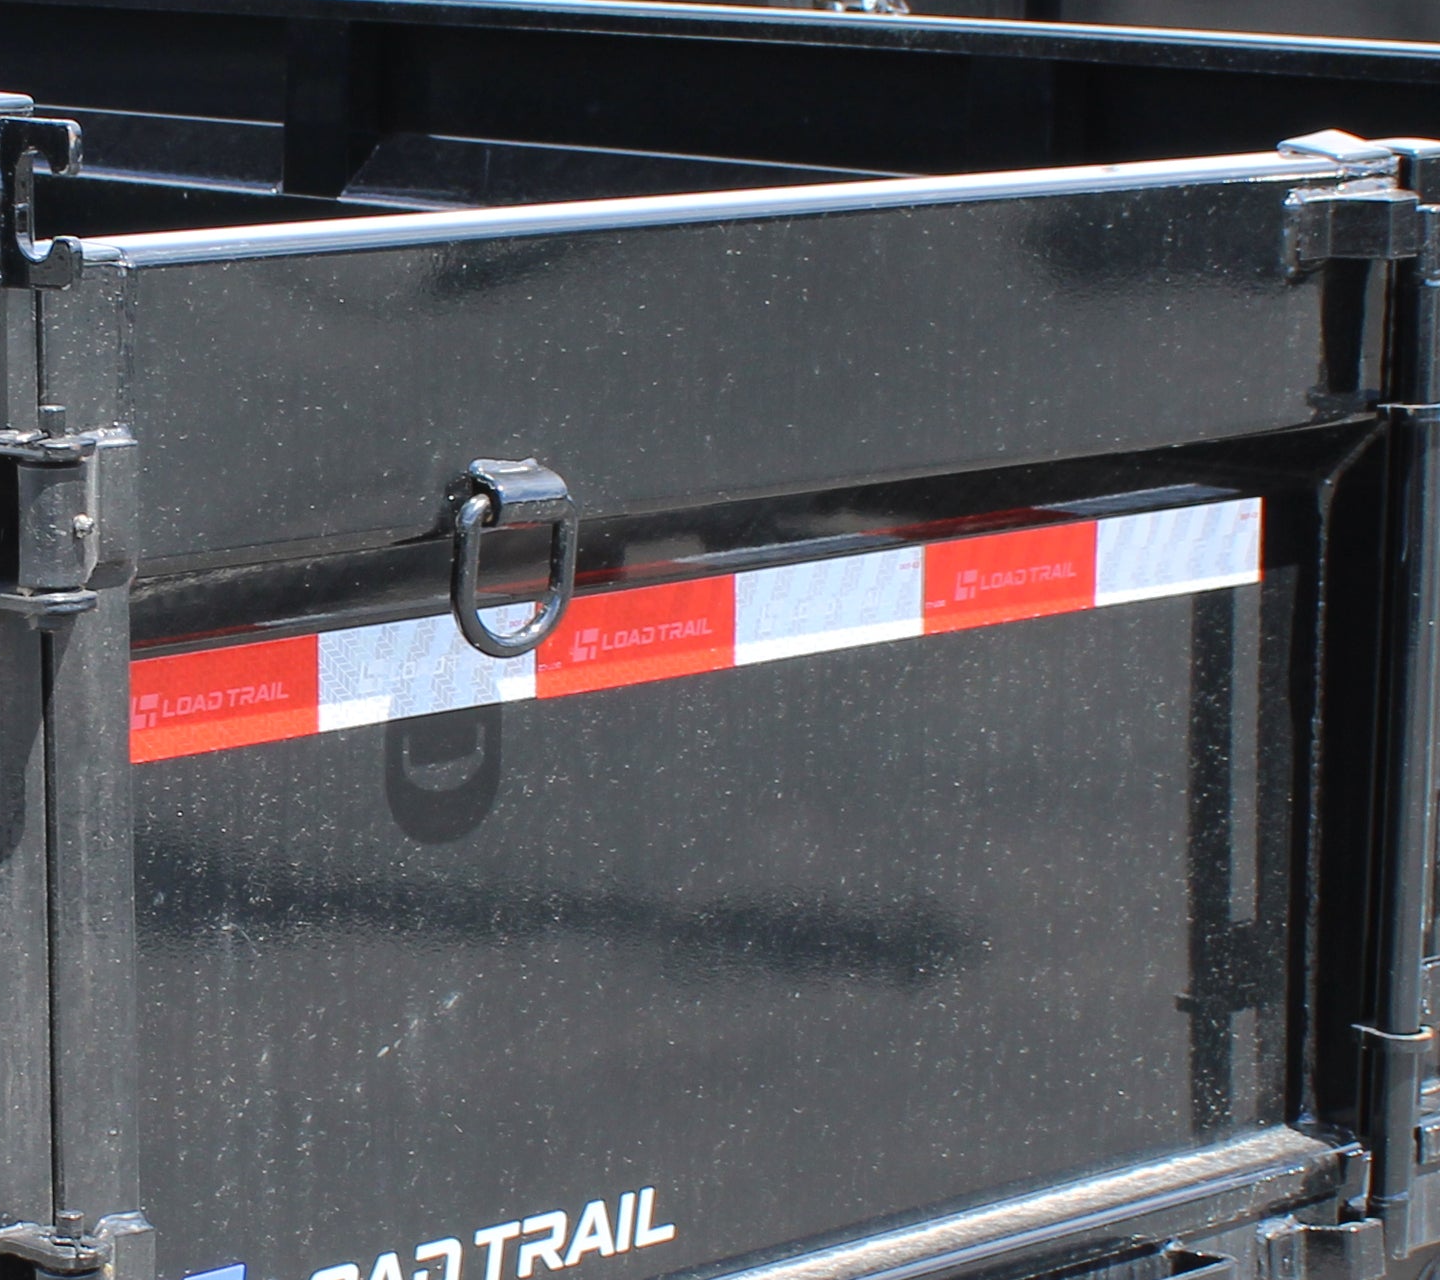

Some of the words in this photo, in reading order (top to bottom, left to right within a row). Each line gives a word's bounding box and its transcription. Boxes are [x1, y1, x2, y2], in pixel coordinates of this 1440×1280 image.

[979, 569, 1026, 592] LOAD
[1030, 560, 1077, 584] TRAIL
[602, 628, 655, 651] LOAD
[657, 618, 712, 640] TRAIL
[162, 691, 223, 719] LOAD
[227, 682, 289, 708] TRAIL
